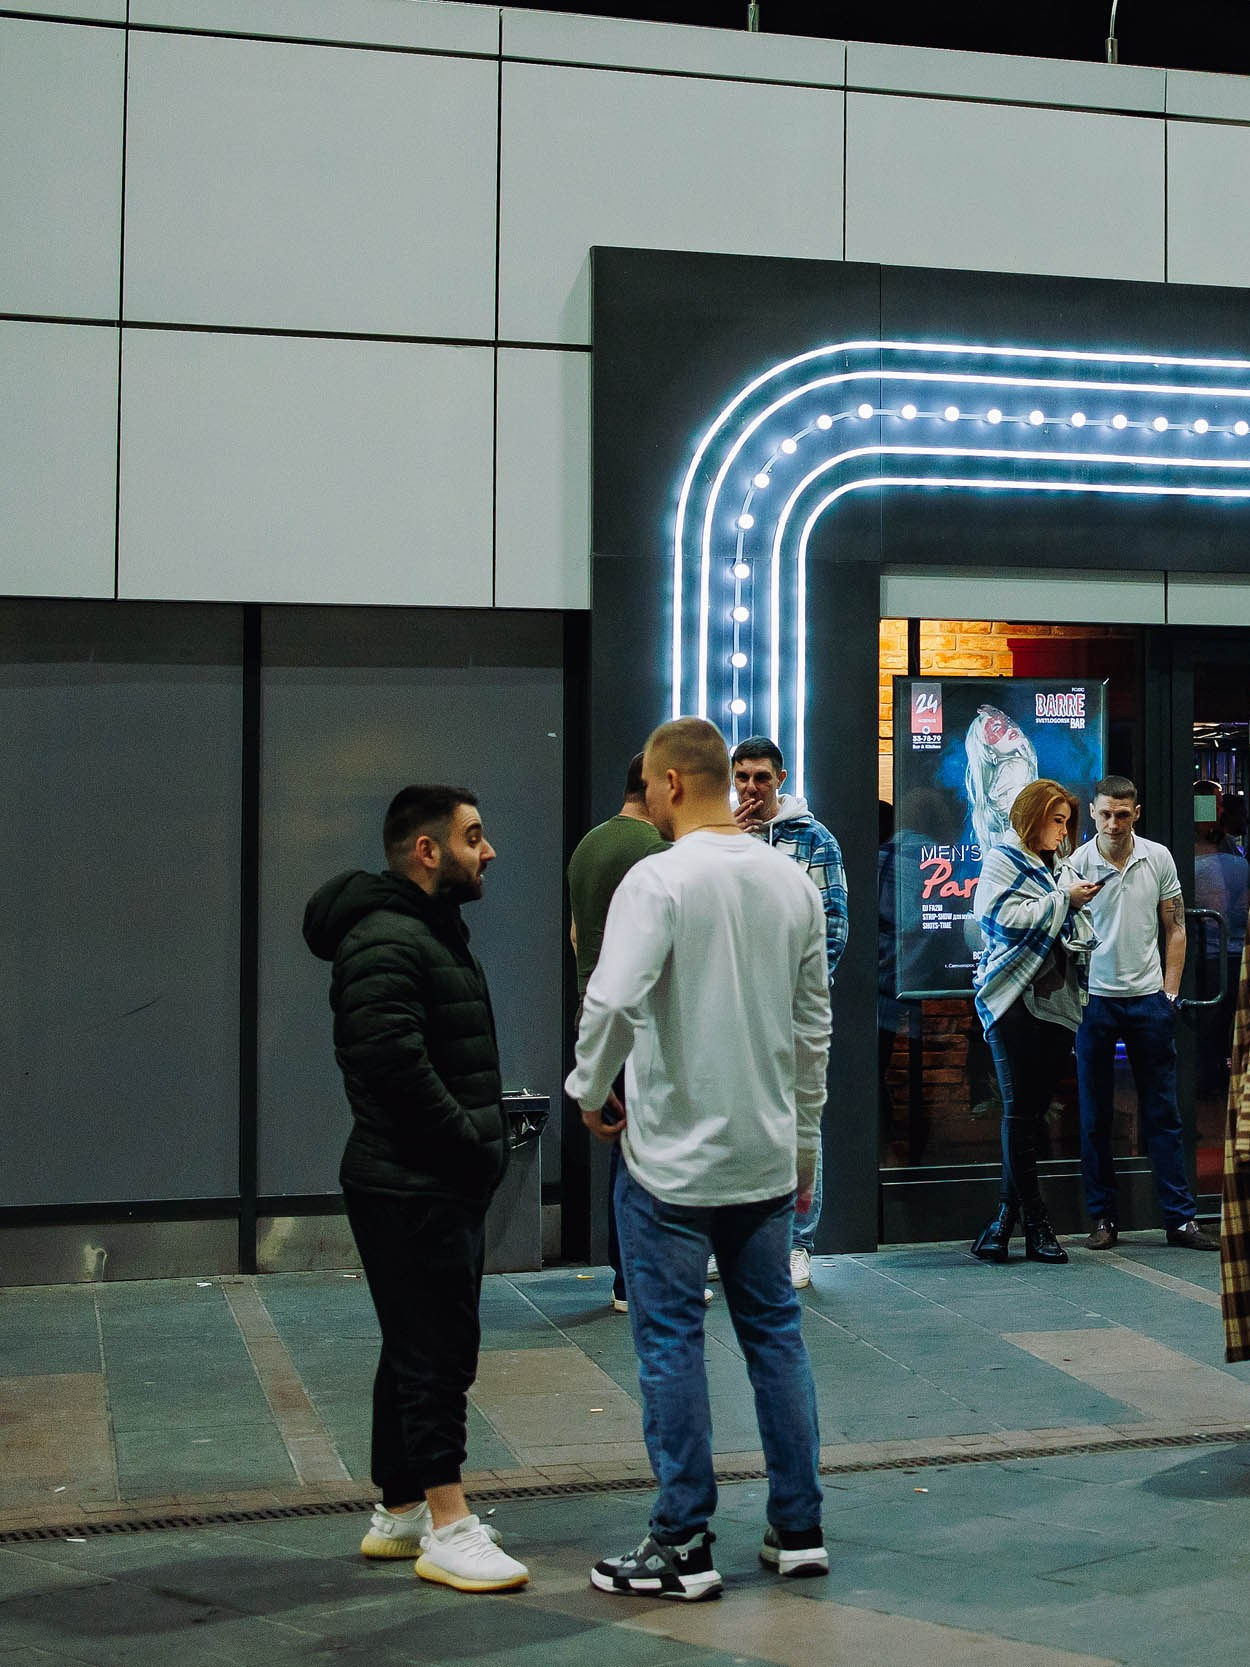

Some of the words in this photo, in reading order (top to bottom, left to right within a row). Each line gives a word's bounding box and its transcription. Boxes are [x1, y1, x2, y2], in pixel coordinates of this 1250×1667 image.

[915, 694, 938, 713] 24
[1035, 693, 1086, 717] BARRE
[1070, 718, 1085, 729] BAR
[912, 734, 942, 742] 33-78-79
[920, 844, 983, 862] MEN'S
